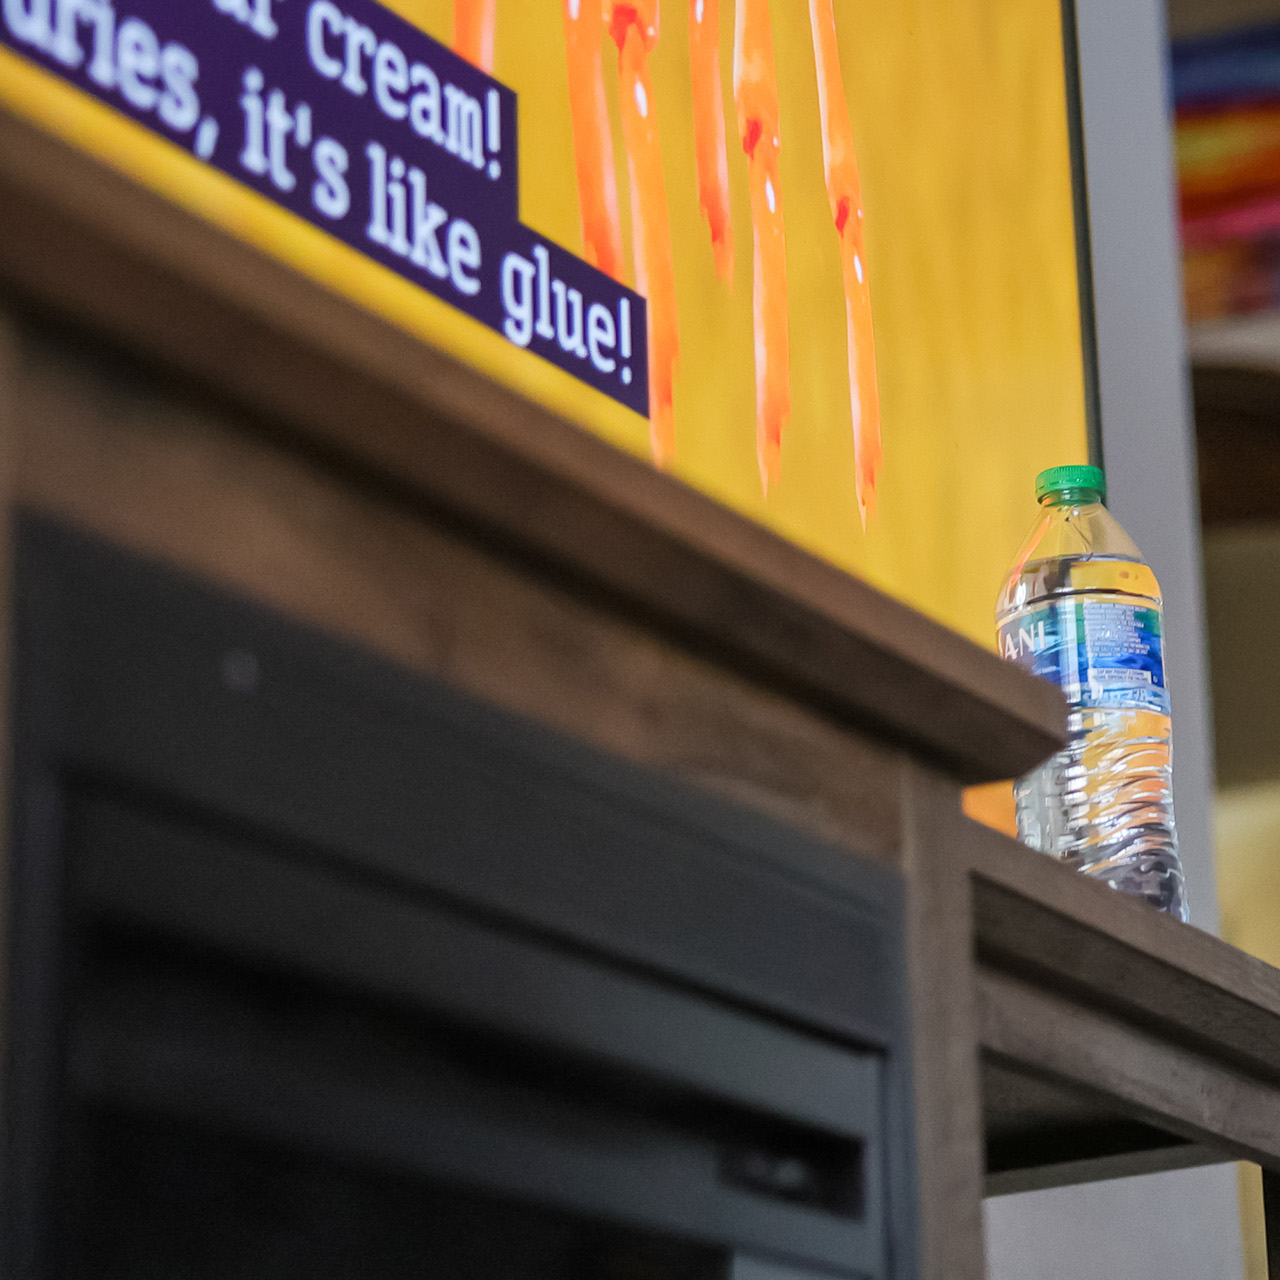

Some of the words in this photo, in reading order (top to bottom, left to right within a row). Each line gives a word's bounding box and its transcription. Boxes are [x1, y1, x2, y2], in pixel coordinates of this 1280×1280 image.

[240, 67, 350, 219] it's
[366, 142, 481, 296] like
[501, 245, 632, 385] glue!
